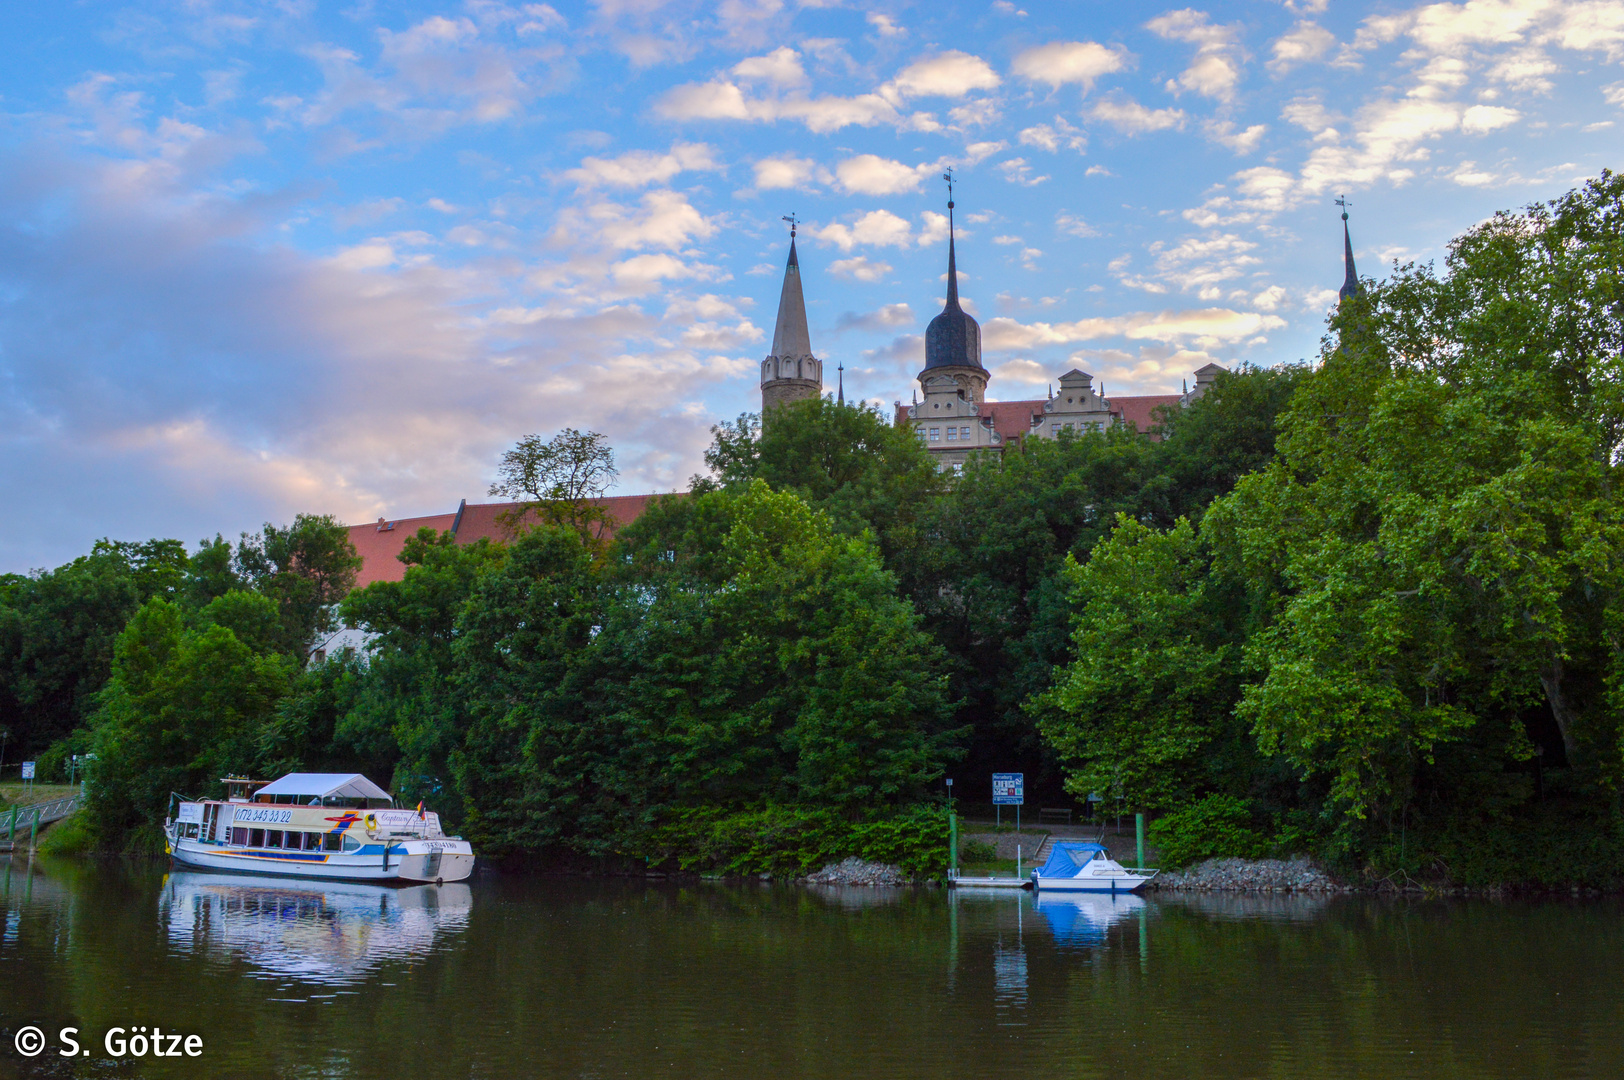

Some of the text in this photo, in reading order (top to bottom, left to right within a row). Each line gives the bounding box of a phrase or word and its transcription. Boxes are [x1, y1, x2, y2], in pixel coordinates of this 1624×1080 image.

[235, 809, 291, 823] 0172 345 33 22
[381, 812, 408, 825] Captain
